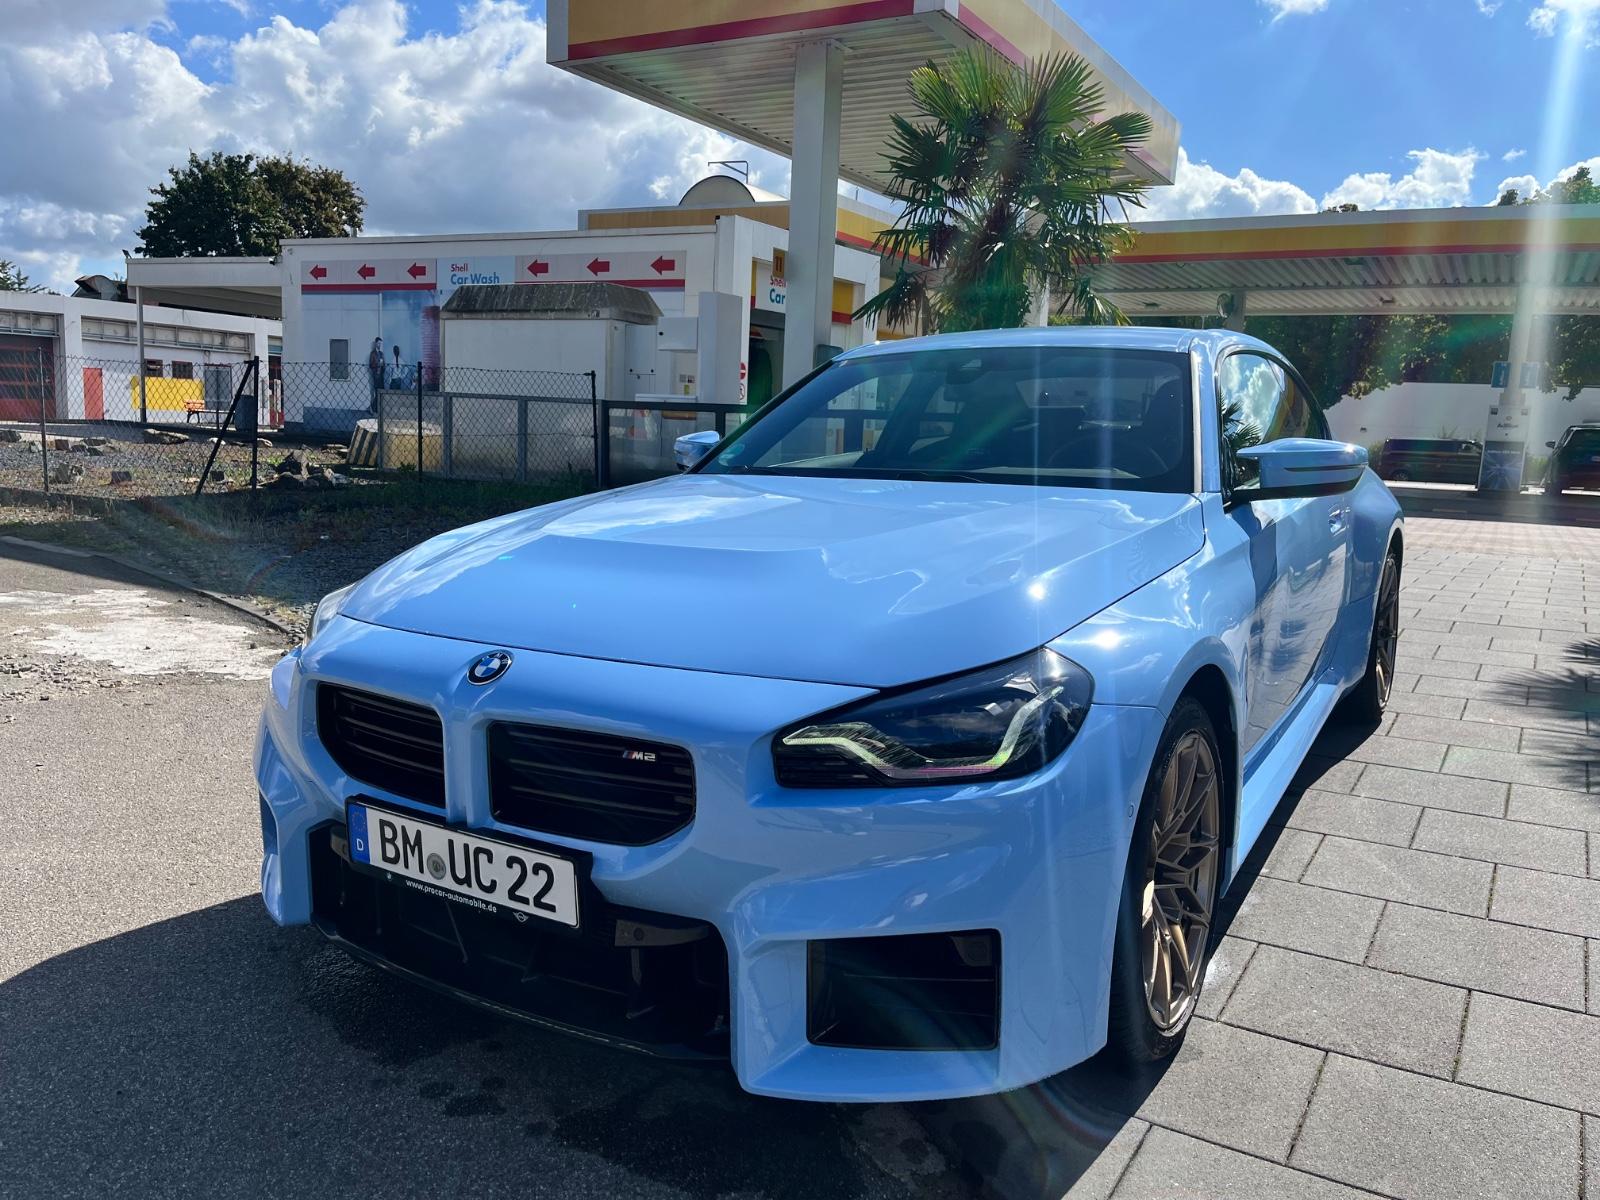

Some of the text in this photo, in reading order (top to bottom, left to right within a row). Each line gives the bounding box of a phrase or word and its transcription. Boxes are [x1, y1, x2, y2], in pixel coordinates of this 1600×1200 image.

[450, 263, 469, 272] Shell
[450, 272, 500, 285] Car Wash
[769, 288, 786, 304] Car
[630, 751, 656, 762] M2
[356, 838, 364, 851] D
[378, 818, 557, 913] BM UC 22
[405, 879, 498, 914] www.procar-automobile.de
